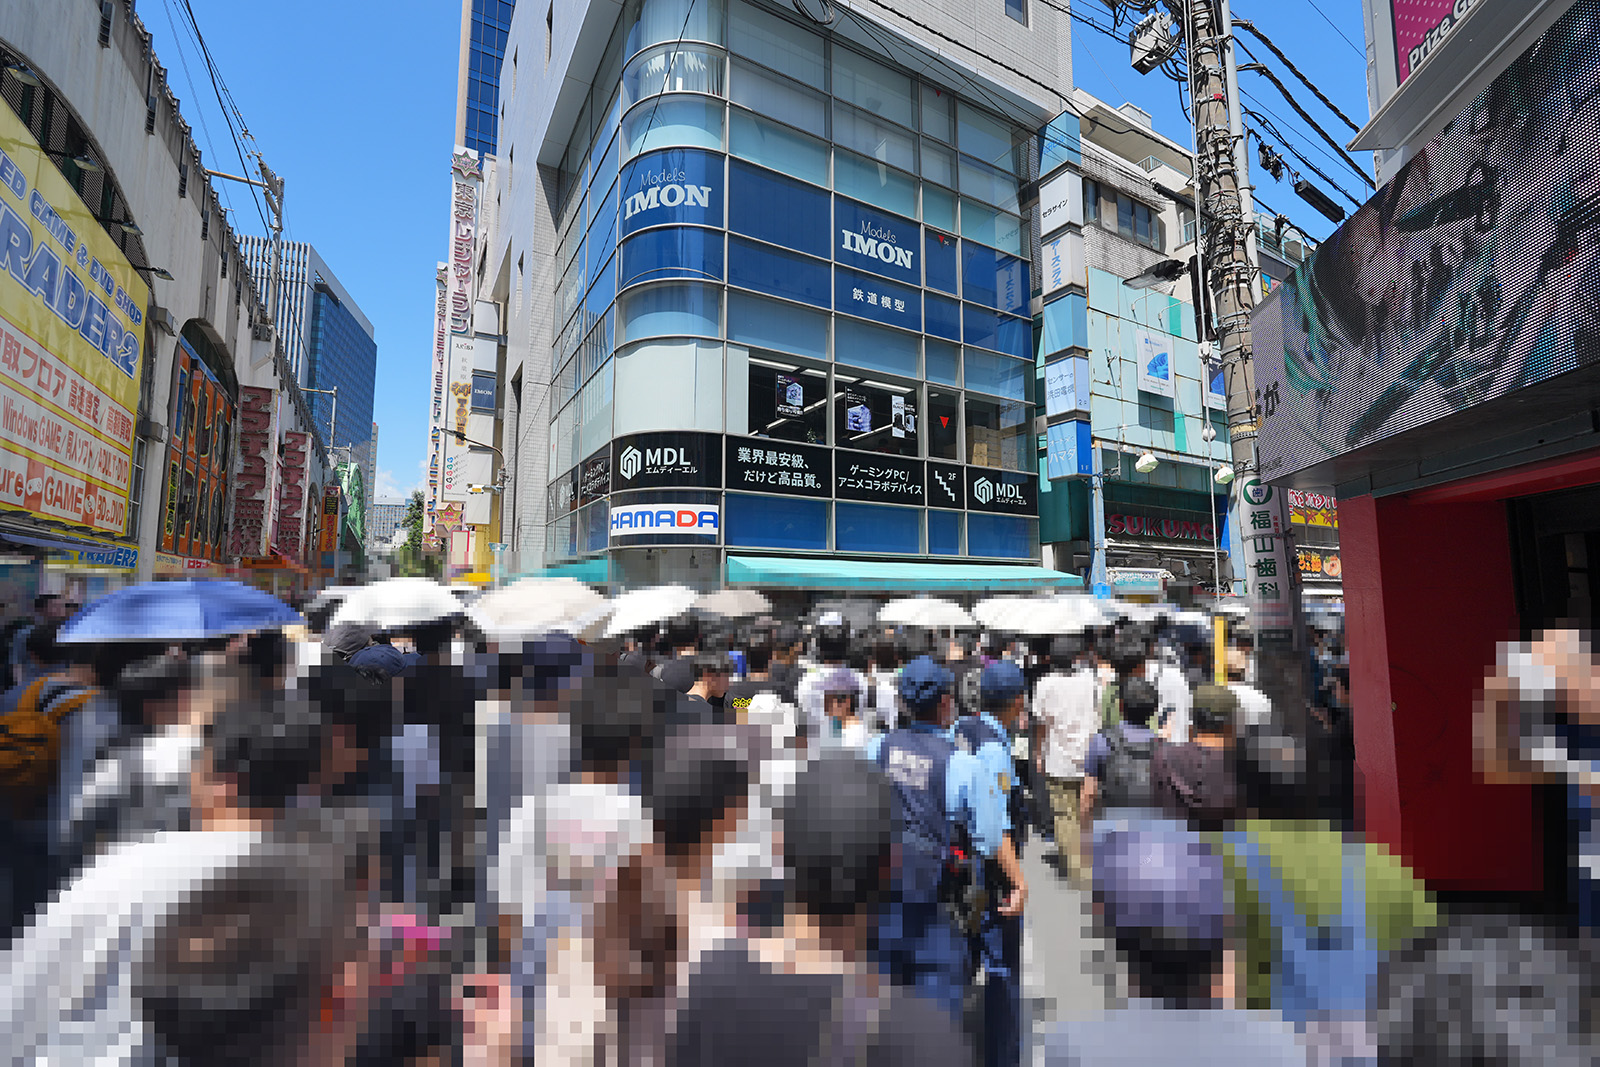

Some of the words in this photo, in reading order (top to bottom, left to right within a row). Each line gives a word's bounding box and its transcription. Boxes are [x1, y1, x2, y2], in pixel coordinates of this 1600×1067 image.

[1409, 17, 1451, 72] Prize
[1453, 0, 1476, 19] G
[639, 168, 686, 190] Models
[624, 183, 712, 221] IMON
[860, 220, 897, 244] Models
[29, 188, 77, 255] GAME
[76, 243, 90, 271] &
[89, 256, 115, 298] DVD
[115, 285, 143, 326] SHOP
[842, 229, 913, 270] IMON
[0, 198, 140, 380] RADER2
[852, 287, 905, 313] 鉄道模型
[0, 328, 67, 398] 取フロア
[474, 388, 492, 396] IMON
[2, 395, 38, 443] Windows
[645, 447, 692, 466] MDL
[737, 447, 810, 469] 業界最安級、
[645, 465, 698, 474] エムディーエル
[743, 470, 822, 489] だけど高品質。
[850, 464, 910, 482] ゲーミングPC/
[948, 472, 957, 481] 2F
[44, 475, 84, 515] GAME
[838, 476, 922, 495] アニメコラボデバイス
[996, 483, 1023, 499] MDL
[996, 497, 1027, 506] エムディーエル
[611, 510, 719, 529] HAMADA
[1104, 513, 1220, 541] SUKUMO
